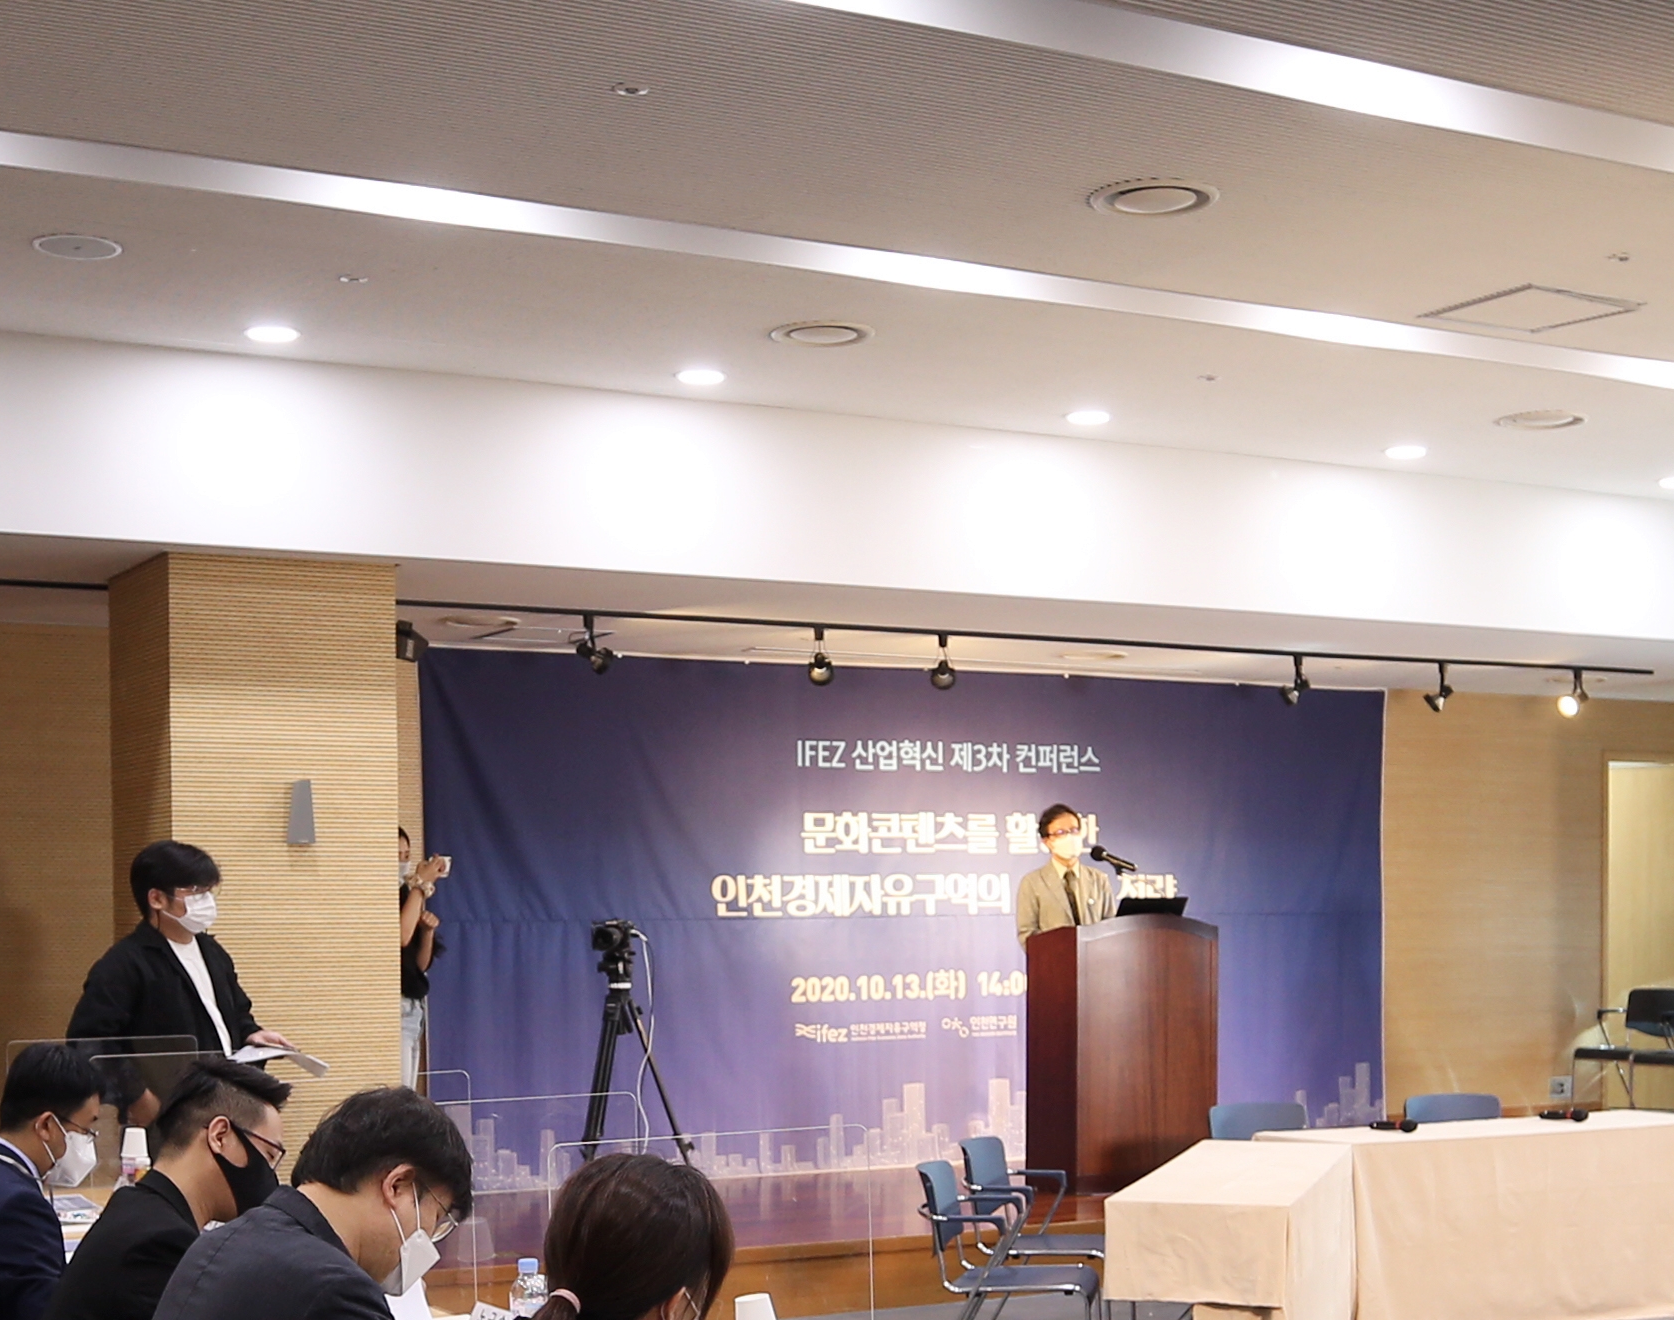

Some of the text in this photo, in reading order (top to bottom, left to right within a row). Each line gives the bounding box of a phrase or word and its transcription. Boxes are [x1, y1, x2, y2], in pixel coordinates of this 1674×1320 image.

[796, 740, 1101, 773] IFEZ 산업혁신 제3차 컨퍼런스
[801, 811, 999, 854] 문화콘텐츠를
[712, 873, 1011, 917] 인천경제자유구역의
[977, 970, 1027, 997] 14:0
[816, 1024, 848, 1043] ifez
